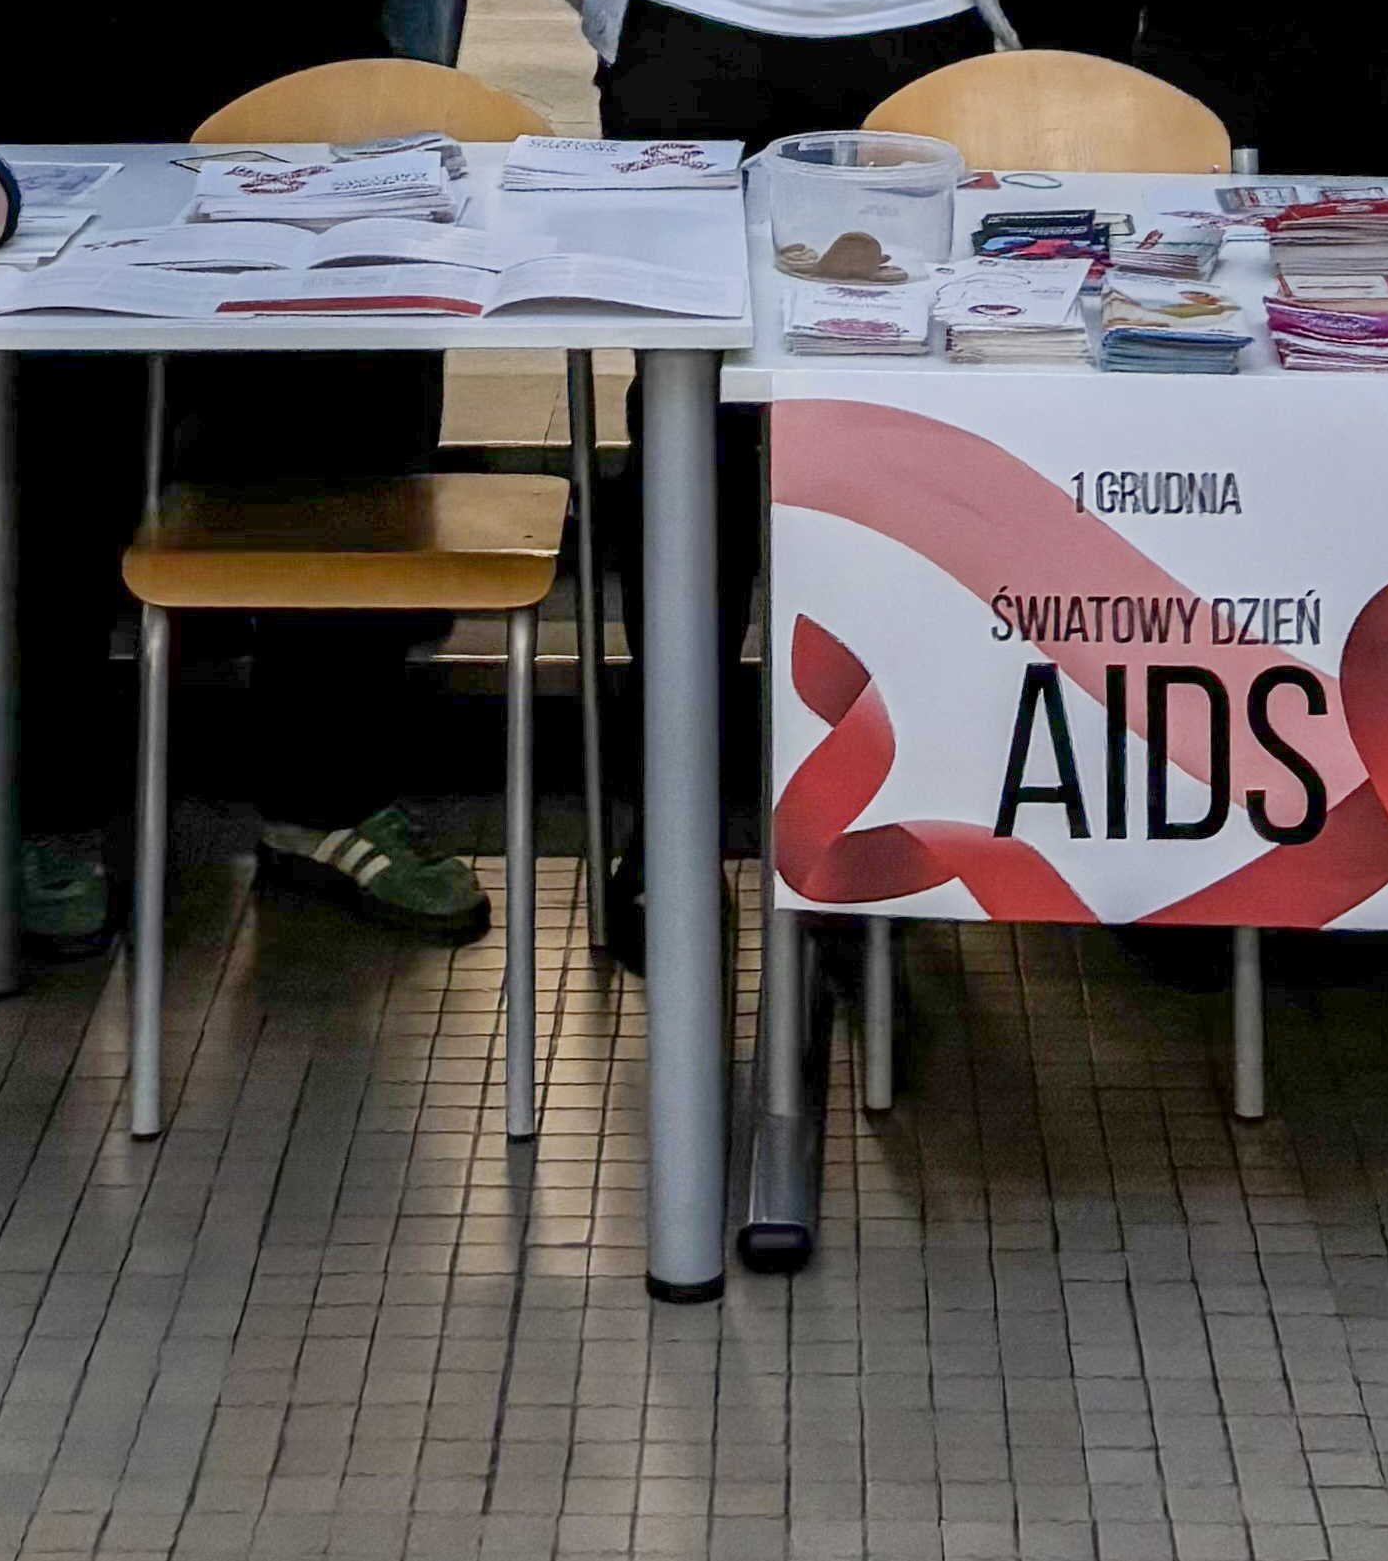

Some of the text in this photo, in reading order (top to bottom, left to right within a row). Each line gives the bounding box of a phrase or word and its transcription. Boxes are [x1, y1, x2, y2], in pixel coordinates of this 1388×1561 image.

[1070, 469, 1243, 516] 1 GRUDNIA
[990, 584, 1322, 647] ŚWIATOWY DZIEŃ
[992, 661, 1330, 847] AIDS
